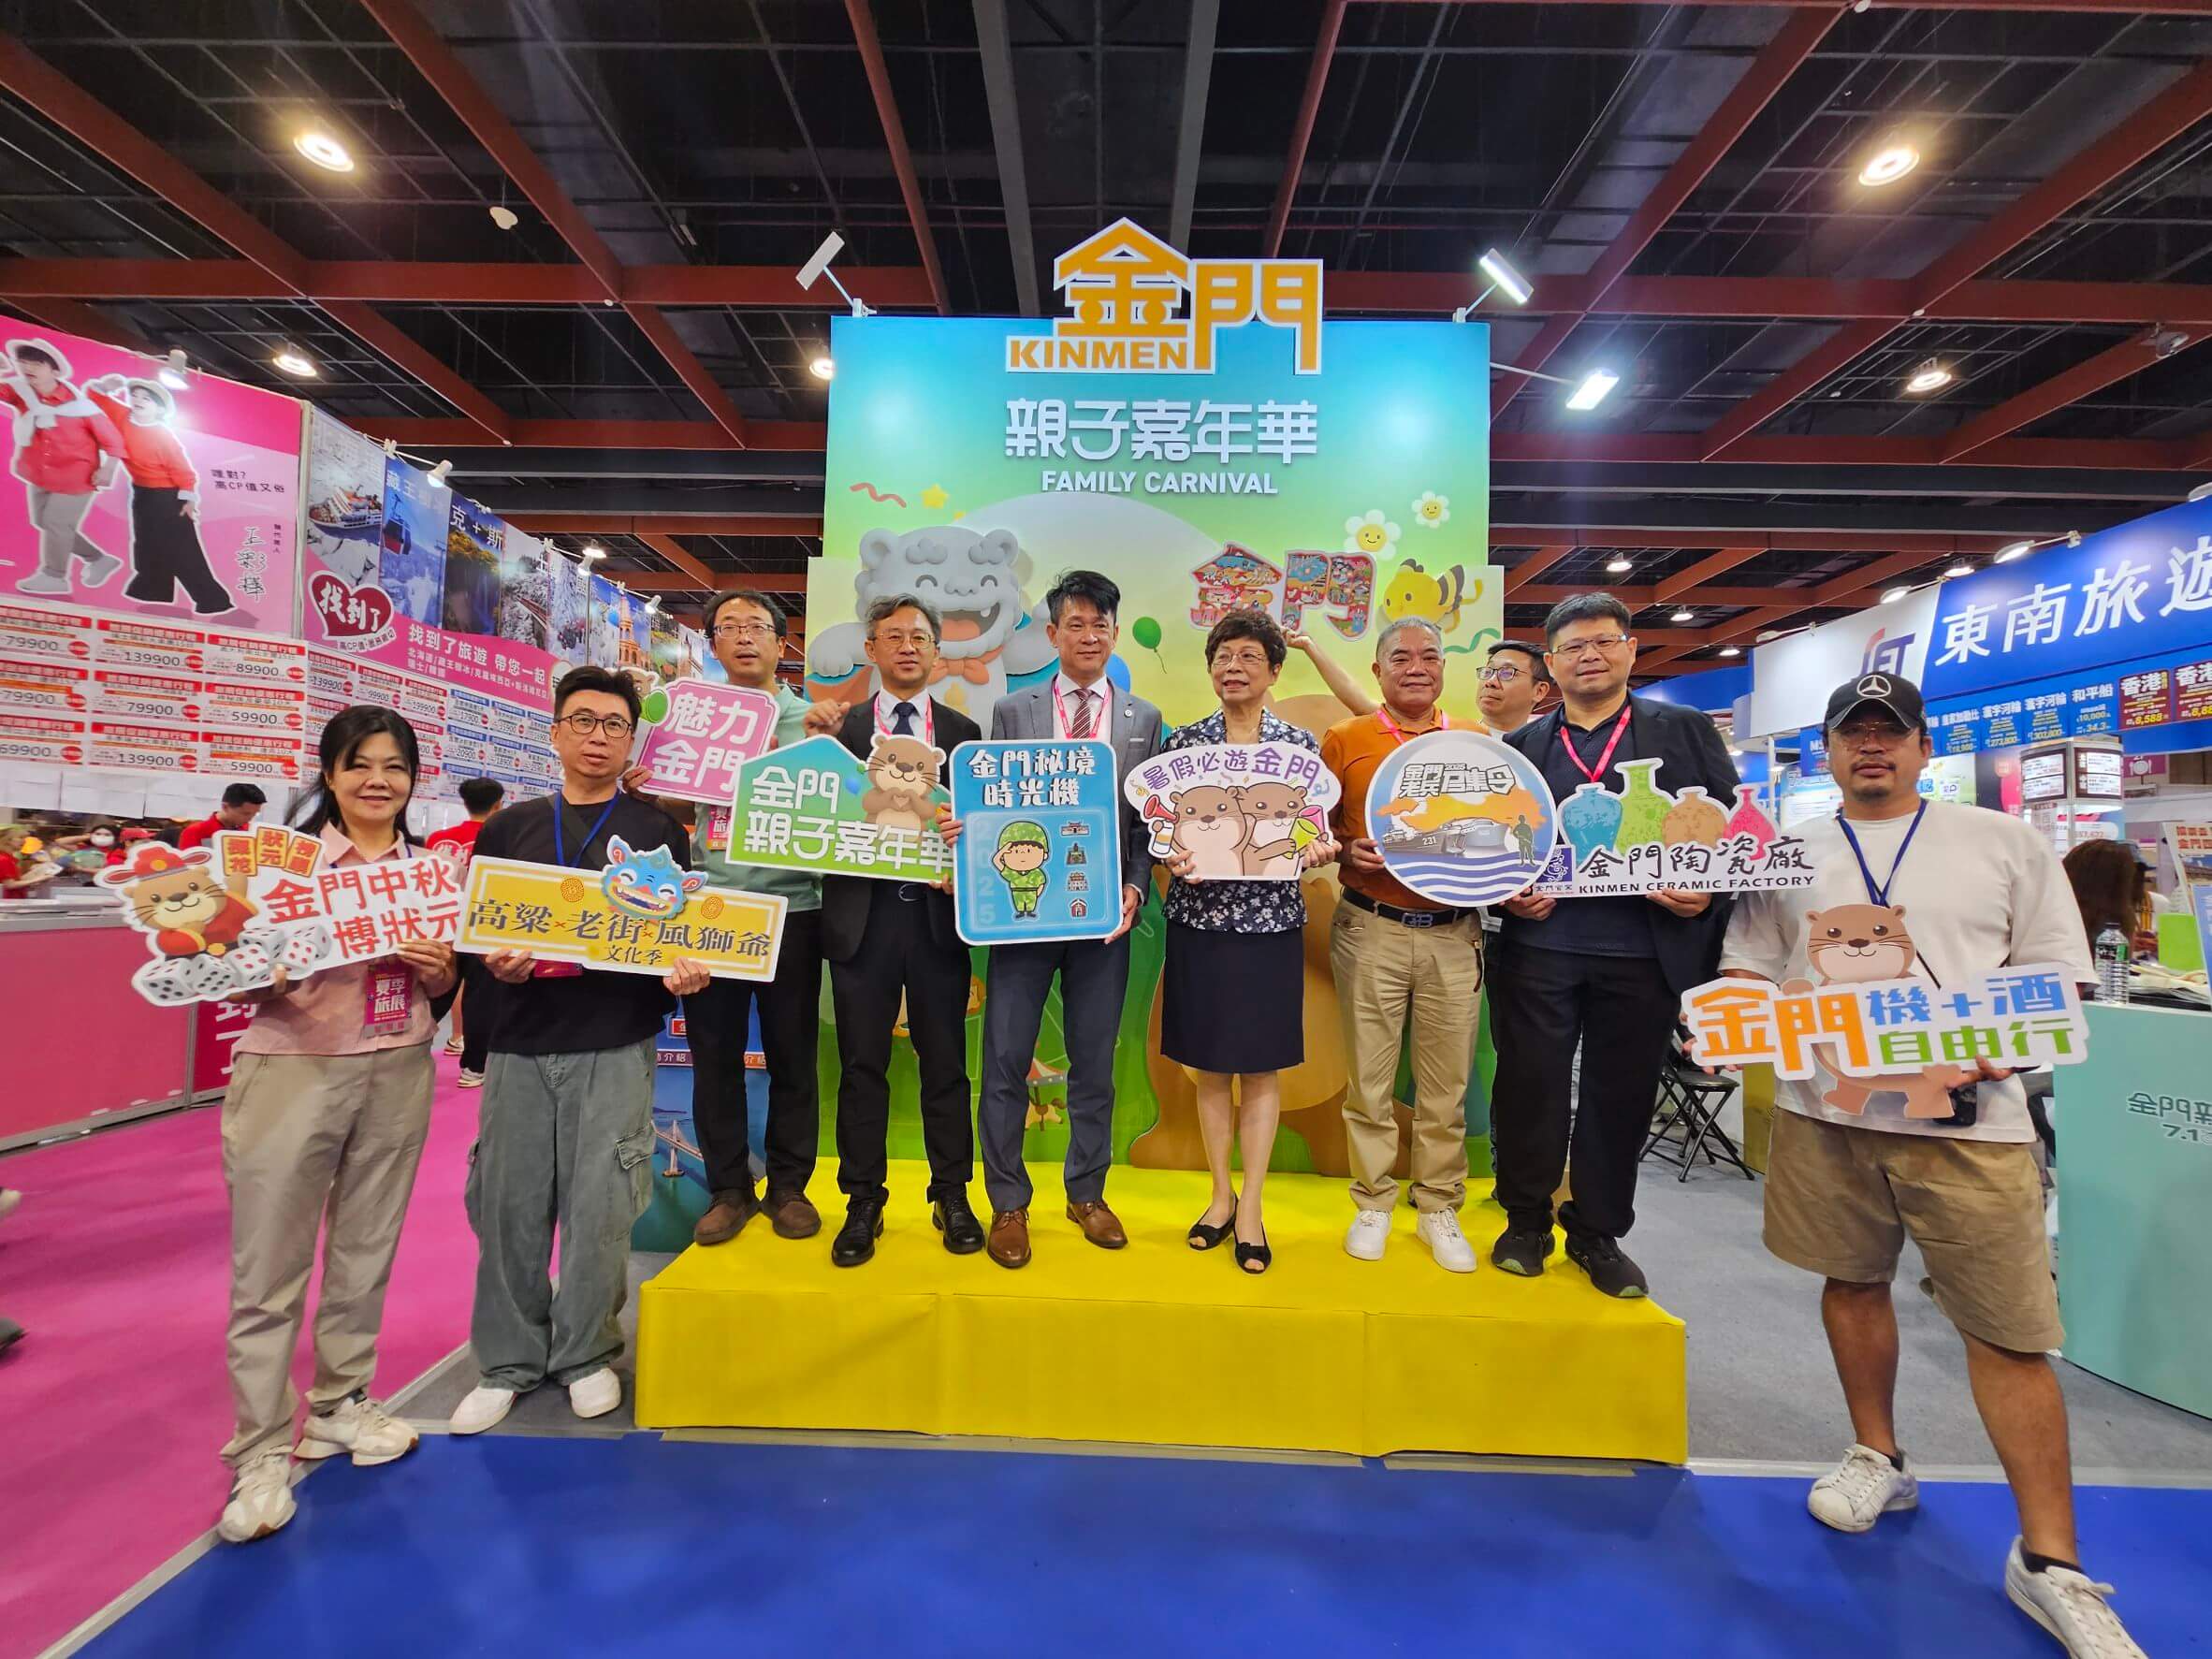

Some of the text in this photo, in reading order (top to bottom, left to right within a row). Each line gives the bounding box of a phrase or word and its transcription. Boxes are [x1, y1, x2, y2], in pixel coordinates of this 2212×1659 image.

[1055, 218, 1322, 373] 金門
[1011, 340, 1187, 369] KINMEN
[1005, 398, 1318, 464] 親子嘉年華
[1041, 471, 1278, 494] FAMILY CARNIVAL
[320, 582, 382, 631] 找到了
[5, 635, 59, 651] 79900
[408, 623, 546, 685] 找到了旅遊 帶您一起
[124, 651, 181, 666] 139900
[236, 663, 279, 677] 89900
[2, 691, 55, 705] 79900
[2071, 683, 2114, 703] 和平船
[2121, 672, 2162, 696] 香港
[126, 702, 174, 716] 79900
[232, 711, 278, 724] 59900
[663, 692, 759, 746] 魅力
[118, 753, 174, 766] 139900
[231, 762, 272, 774] 59900
[651, 739, 746, 793] 金門
[968, 746, 1097, 779] 金門秘境
[1142, 747, 1320, 791] 暑假必遊金門
[749, 766, 841, 814] 金門
[984, 778, 1079, 808] 時光機
[744, 809, 953, 875] 親子嘉年華
[1422, 837, 1436, 846] 231
[1579, 835, 1815, 880] 金門陶瓷廠
[261, 858, 458, 925] 金門中秋
[1579, 876, 1814, 894] KINMEN CERAMIC FACTORY
[332, 898, 461, 960] 博狀元
[604, 945, 664, 967] 文化季
[375, 994, 405, 1013] 旅展
[1866, 971, 2066, 1026] 機+酒
[1692, 985, 1870, 1071] 金門
[1878, 1017, 2074, 1066] 自由行
[657, 1053, 686, 1063] 介紹
